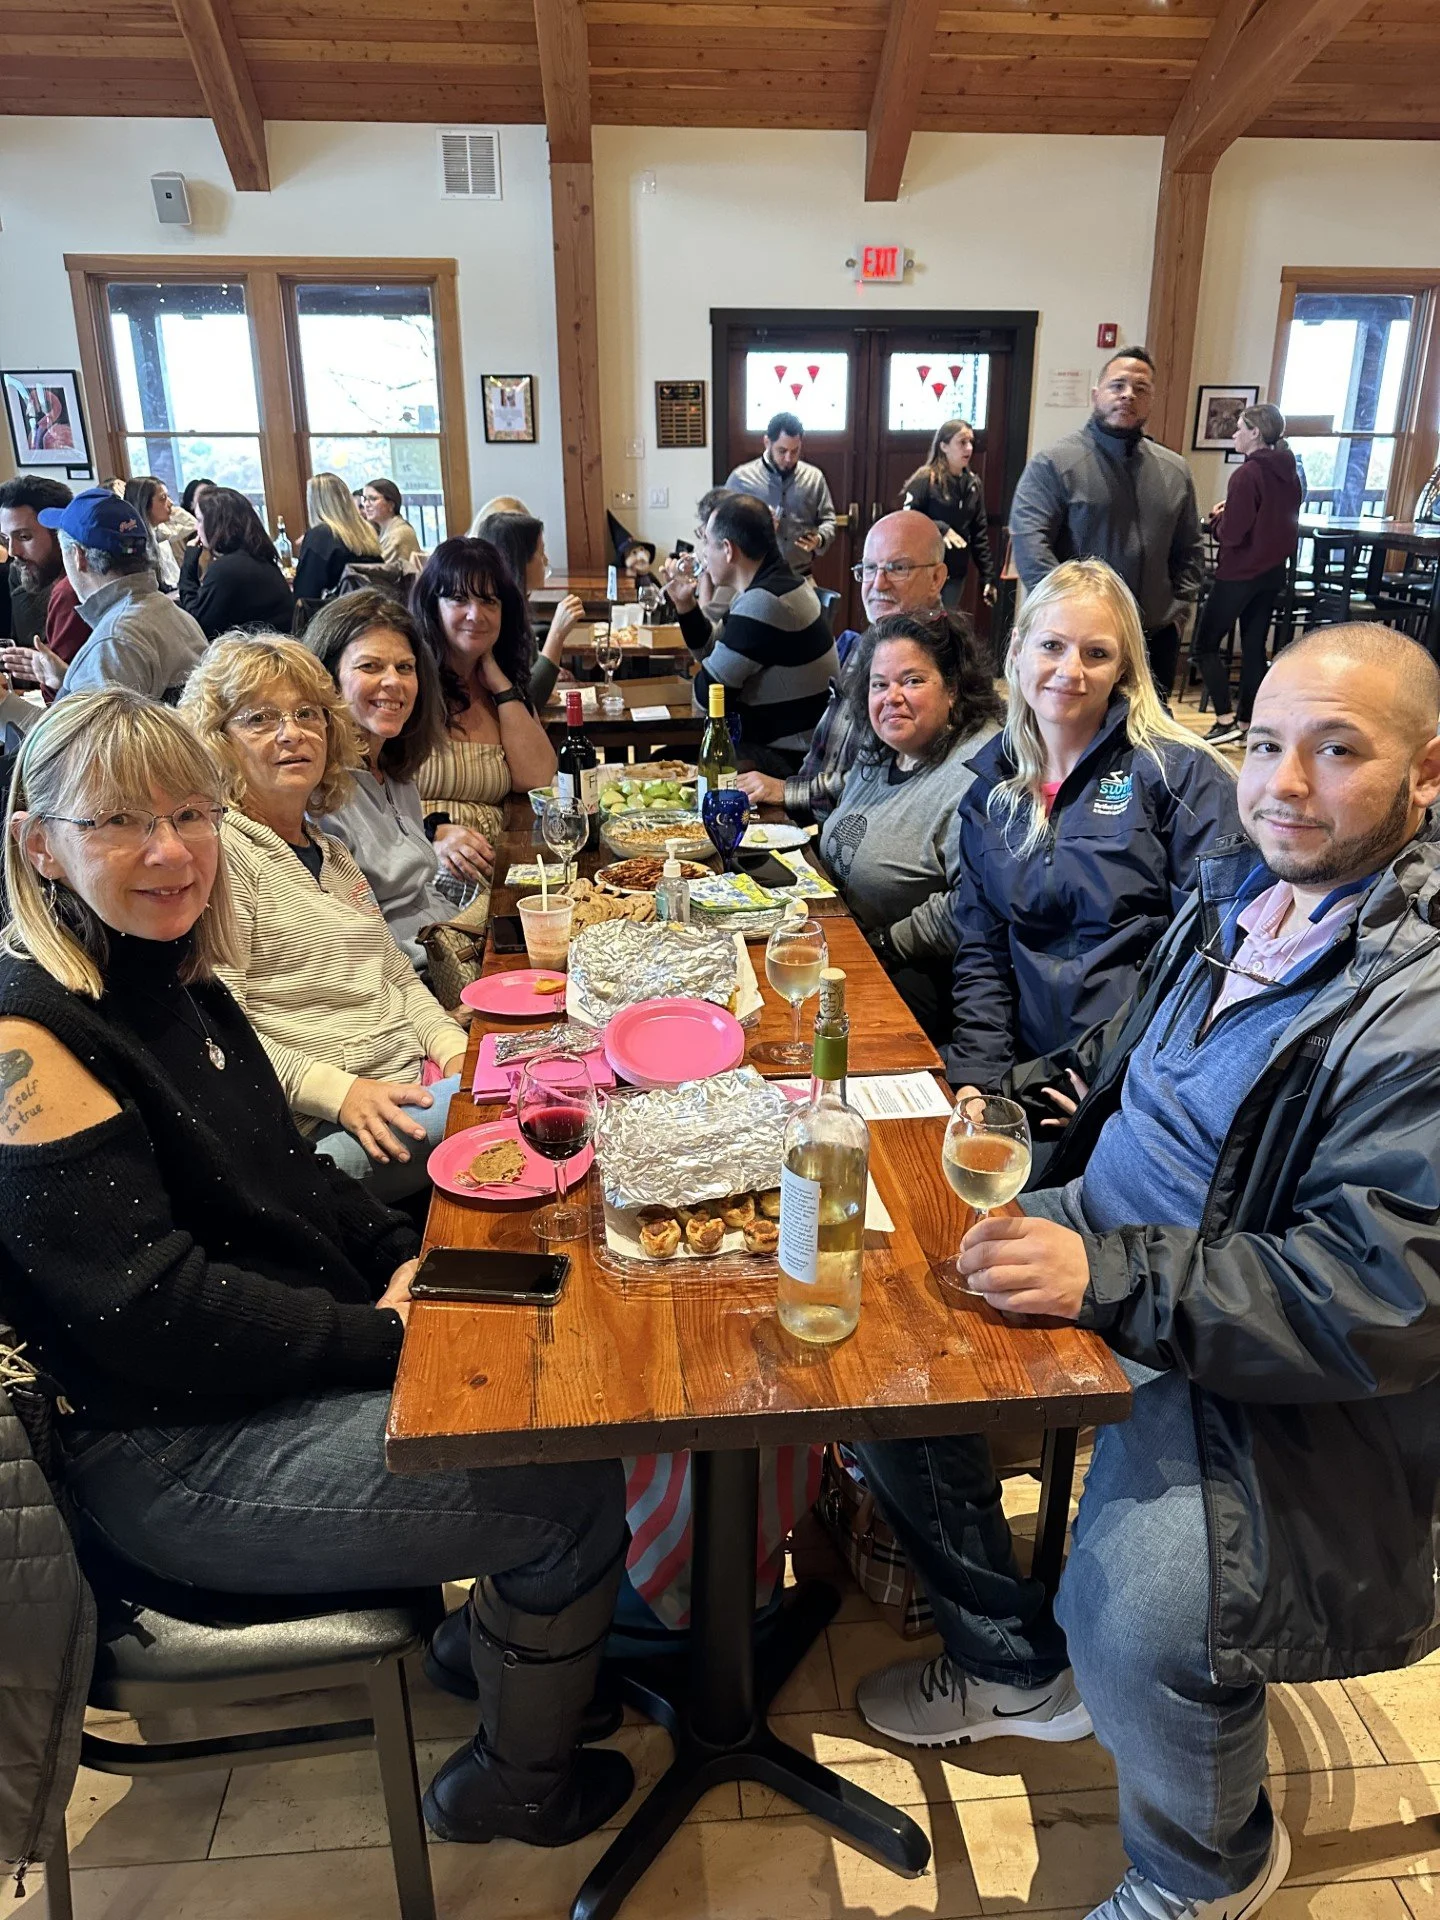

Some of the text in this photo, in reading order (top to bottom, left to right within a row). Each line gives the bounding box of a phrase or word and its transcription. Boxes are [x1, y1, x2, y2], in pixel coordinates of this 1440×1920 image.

[863, 246, 899, 277] EXIT
[15, 1079, 39, 1105] self
[7, 1103, 44, 1136] be true
